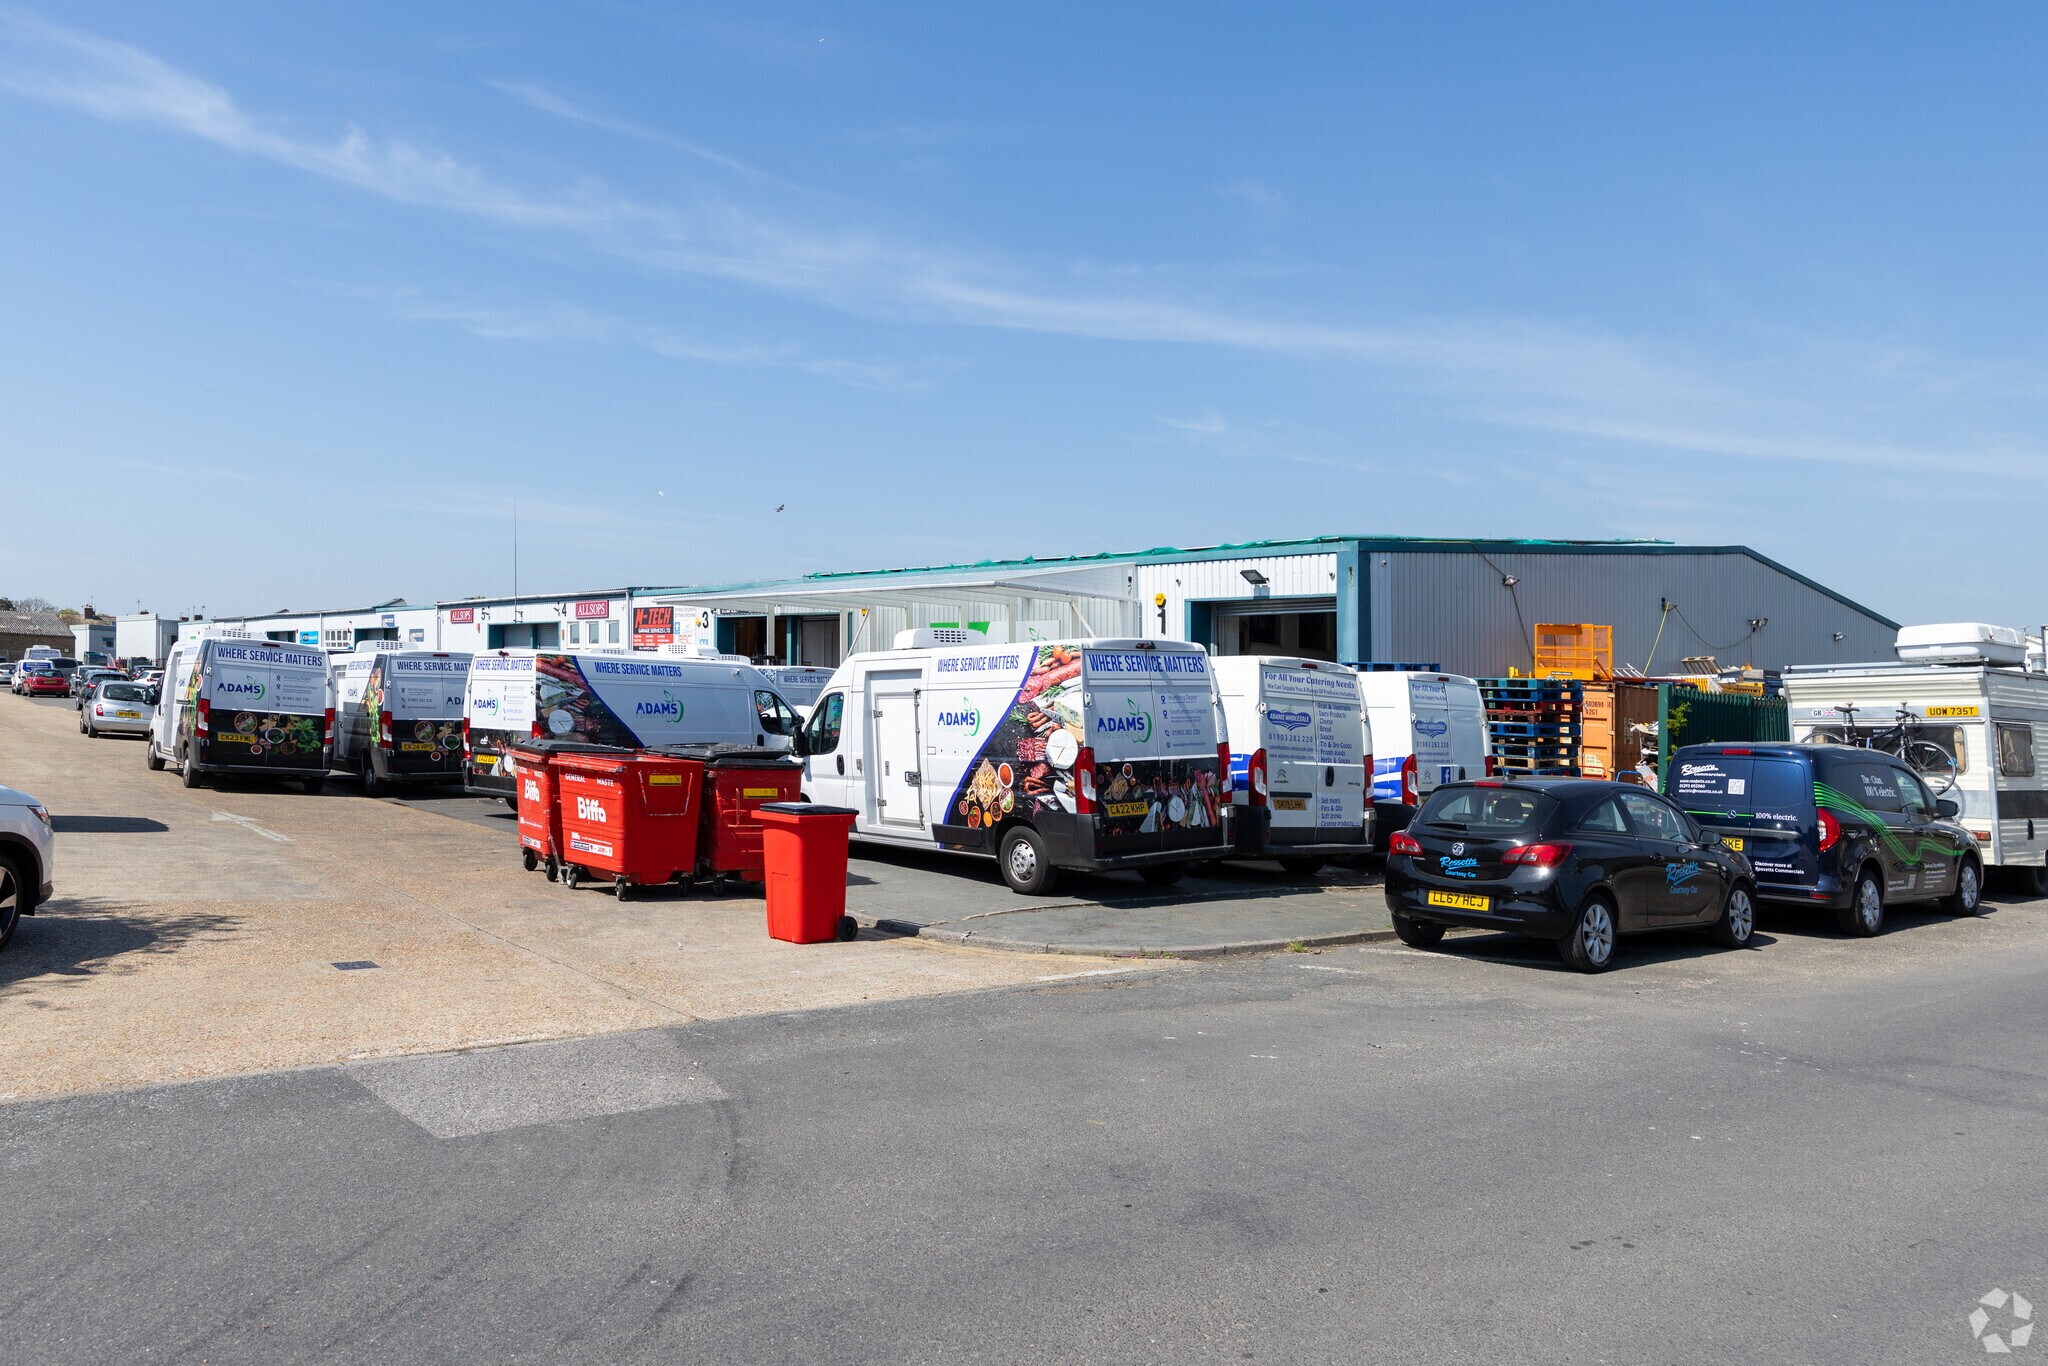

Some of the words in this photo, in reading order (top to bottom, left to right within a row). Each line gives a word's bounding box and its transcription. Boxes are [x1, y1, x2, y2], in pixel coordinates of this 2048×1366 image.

[481, 607, 486, 621] 5
[562, 602, 567, 617] 4
[577, 603, 607, 618] ALLSOPS
[451, 610, 472, 622] ALLSOPS
[635, 608, 672, 629] M-TECH
[702, 611, 709, 629] 3
[217, 646, 248, 661] WHERE
[249, 649, 284, 664] SERVICE
[285, 652, 323, 667] MATTERS
[397, 661, 422, 671] WHERE
[424, 662, 453, 672] SERVICE
[454, 663, 471, 672] MATT
[476, 659, 491, 670] WHERE
[491, 659, 510, 670] SERVICE
[510, 660, 533, 671] MATTERS
[594, 661, 621, 674] WHERE
[621, 663, 650, 676] SERVICE
[651, 664, 683, 677] MATTERS
[938, 658, 959, 673] WHERE
[960, 656, 987, 671] SERVICE
[988, 655, 1019, 670] MATTERS
[1089, 654, 1124, 672] WHERE
[1125, 655, 1164, 673] SERVICE
[1164, 656, 1204, 673] MATTERS
[784, 675, 799, 683] WHERE
[799, 675, 816, 684] SERVICE
[1265, 672, 1277, 680] For
[1278, 673, 1288, 682] All
[1289, 675, 1305, 684] Your
[1306, 677, 1335, 689] Catering
[1336, 680, 1355, 690] Needs
[217, 682, 261, 695] ADAMS
[1428, 685, 1440, 693] Your
[473, 699, 496, 709] ADAMS
[636, 702, 678, 714] ADAMS
[1319, 710, 1329, 718] Dairy
[1330, 711, 1347, 719] Products
[1813, 709, 1822, 717] GB
[1929, 708, 1948, 716] UOW
[1949, 706, 1975, 715] 735T
[938, 712, 976, 725] ADAMS
[1270, 712, 1286, 721] ADAMS
[1286, 714, 1309, 723] WHOLESALE
[1320, 717, 1333, 725] Cheese
[1097, 716, 1145, 732] ADAMS
[221, 733, 239, 741] CK23
[1097, 732, 1146, 740] FOODSERVICE
[1268, 733, 1288, 741] 01903
[1289, 734, 1301, 742] 282
[1302, 735, 1313, 743] 220
[1681, 764, 1719, 776] Rossetts
[565, 774, 587, 783] GENERAL
[596, 778, 615, 787] WASTE
[1861, 774, 1870, 784] The
[524, 779, 540, 802] Biffa
[577, 796, 607, 823] Biffa
[1110, 804, 1130, 815] CA22
[1130, 803, 1145, 813] KHP
[1321, 812, 1330, 820] Soft
[1755, 812, 1772, 820] 100%
[1772, 813, 1798, 821] electric.
[1440, 856, 1480, 869] Rossetts
[1445, 870, 1466, 879] Courtesy
[1670, 886, 1690, 895] Courtesy
[1433, 891, 1461, 904] LL67
[1462, 895, 1485, 908] HCJ
